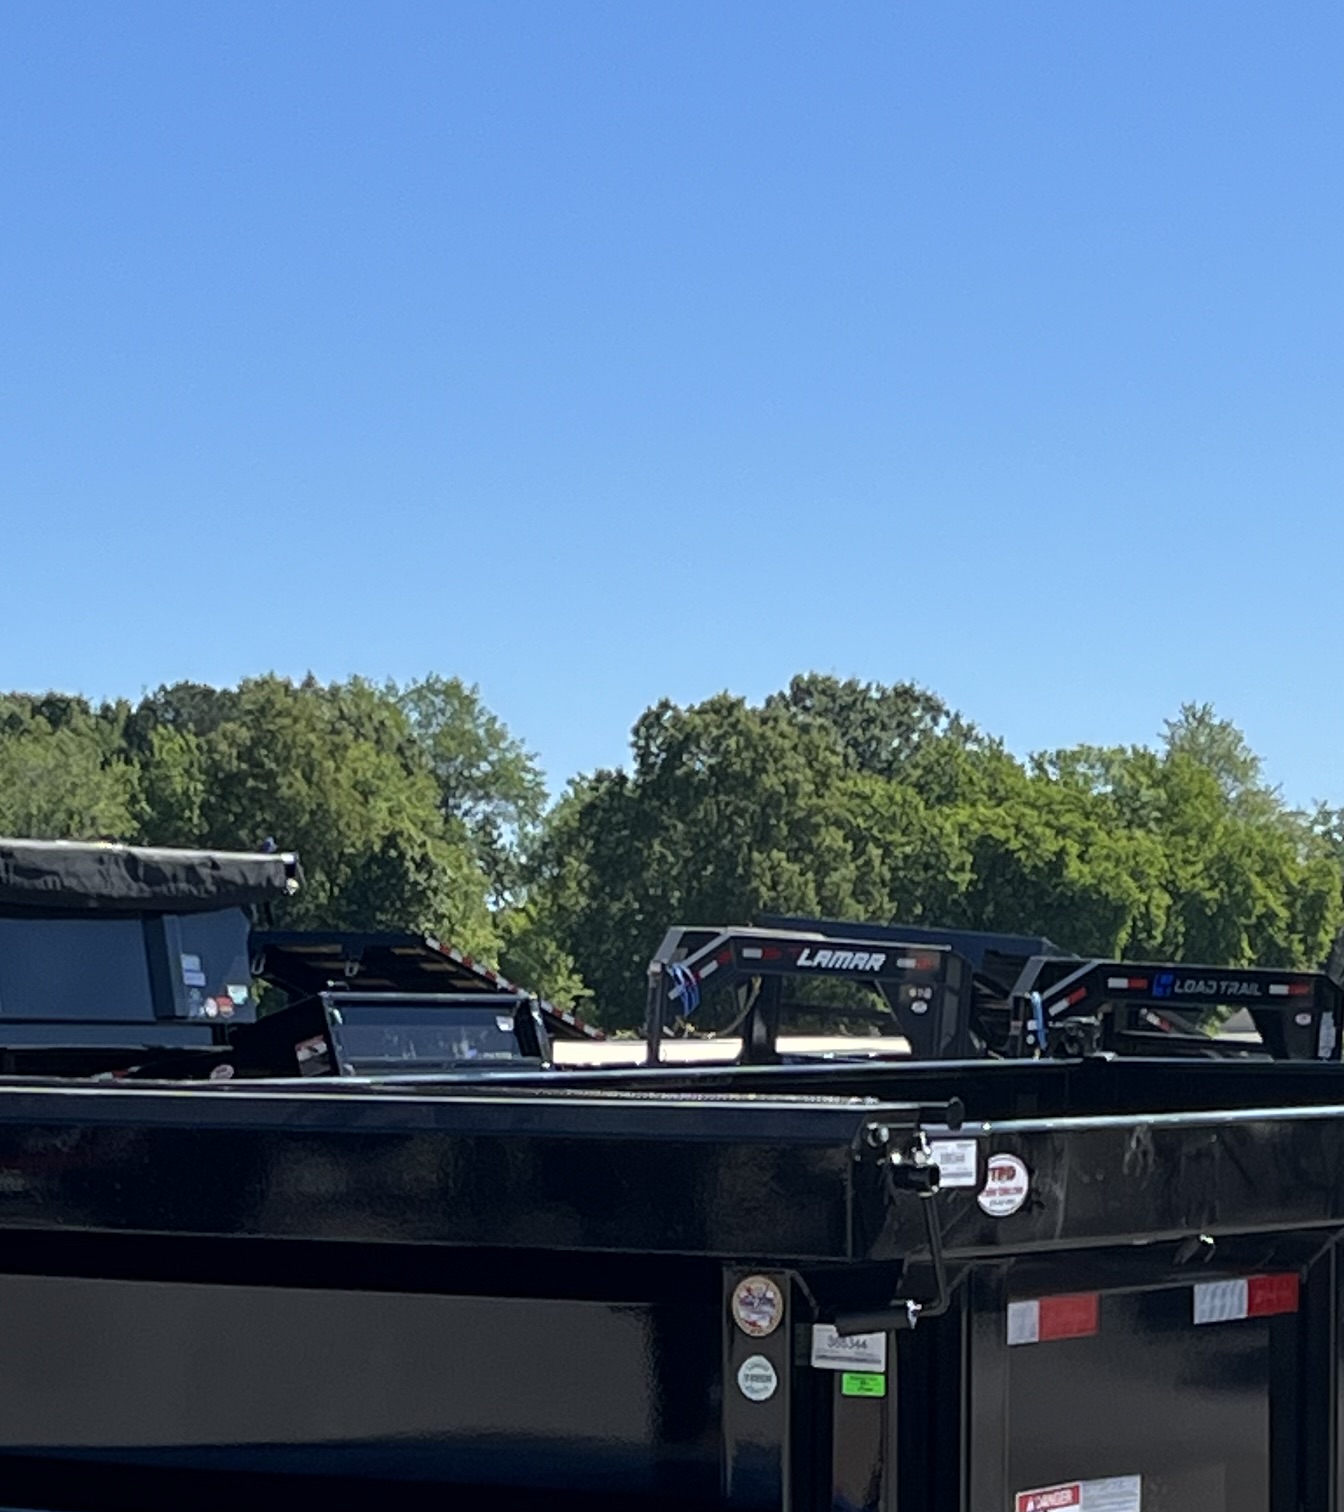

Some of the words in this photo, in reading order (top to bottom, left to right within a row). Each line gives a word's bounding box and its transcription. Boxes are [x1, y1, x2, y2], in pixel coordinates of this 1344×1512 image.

[796, 947, 886, 972] LAMAR
[1174, 979, 1217, 995] LOAD
[1219, 981, 1263, 996] TRAIL
